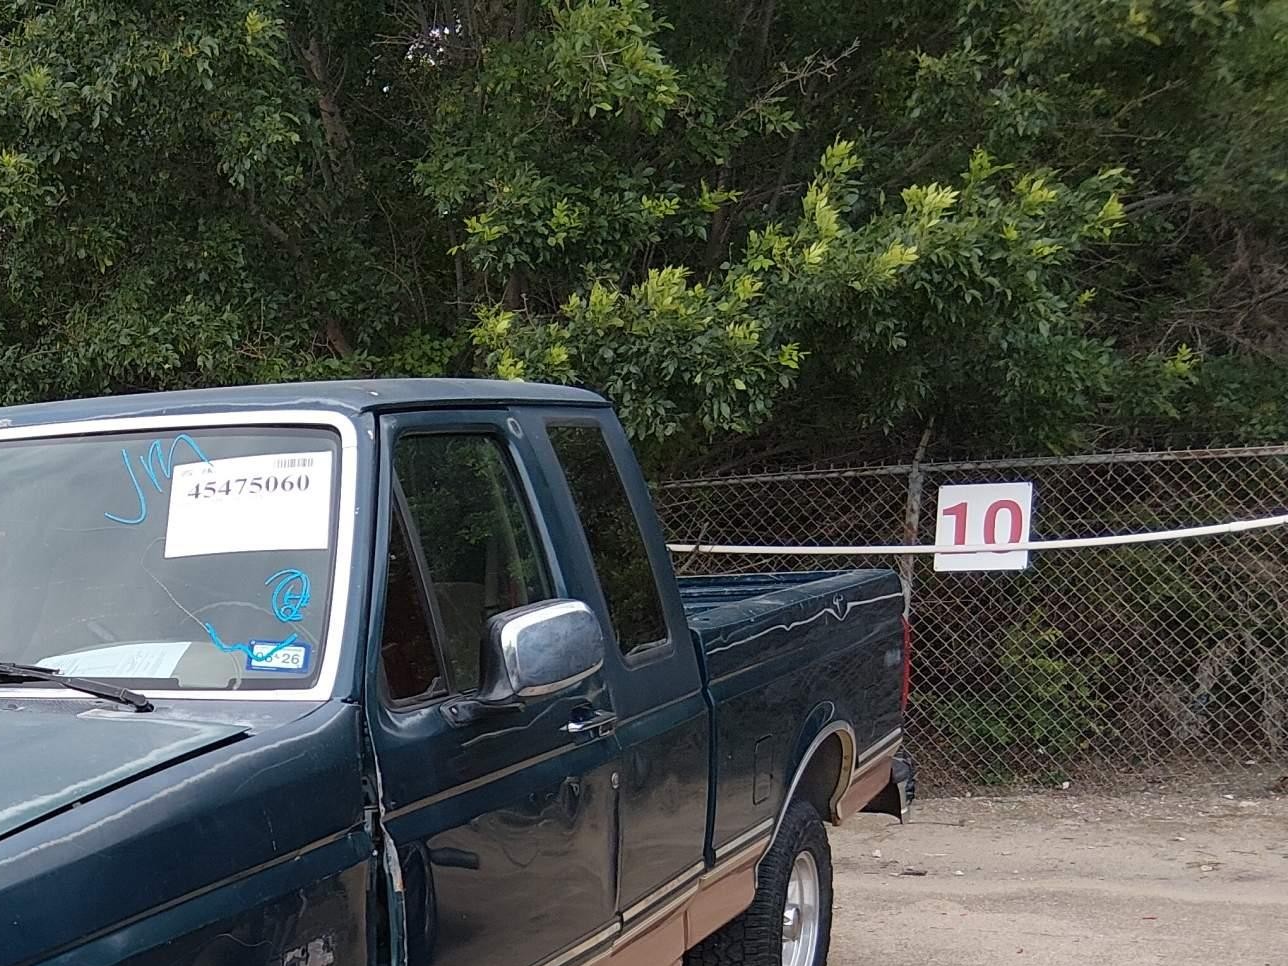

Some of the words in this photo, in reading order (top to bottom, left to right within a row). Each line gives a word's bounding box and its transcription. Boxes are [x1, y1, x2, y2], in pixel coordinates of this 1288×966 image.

[187, 474, 310, 499] 45475060
[942, 499, 1023, 554] 10
[281, 653, 300, 664] 26
